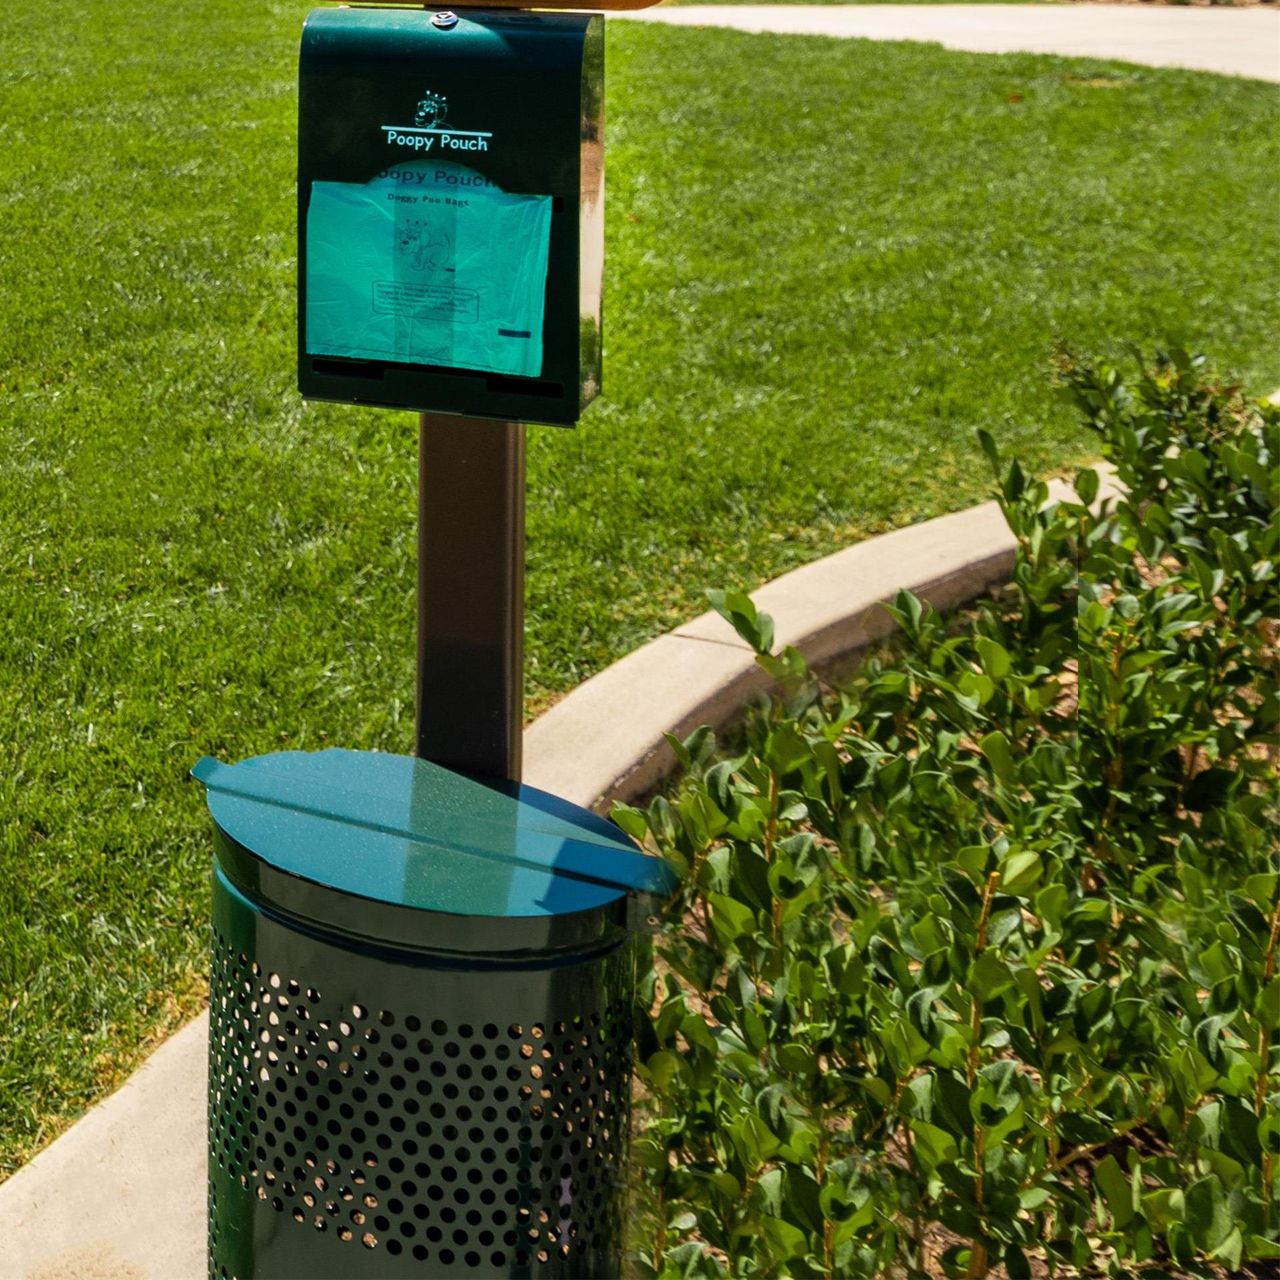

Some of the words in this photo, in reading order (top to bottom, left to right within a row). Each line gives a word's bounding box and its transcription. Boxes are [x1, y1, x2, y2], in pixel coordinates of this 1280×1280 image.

[387, 130, 434, 151] Poopy
[440, 134, 488, 151] Pouch
[377, 170, 427, 185] oopy
